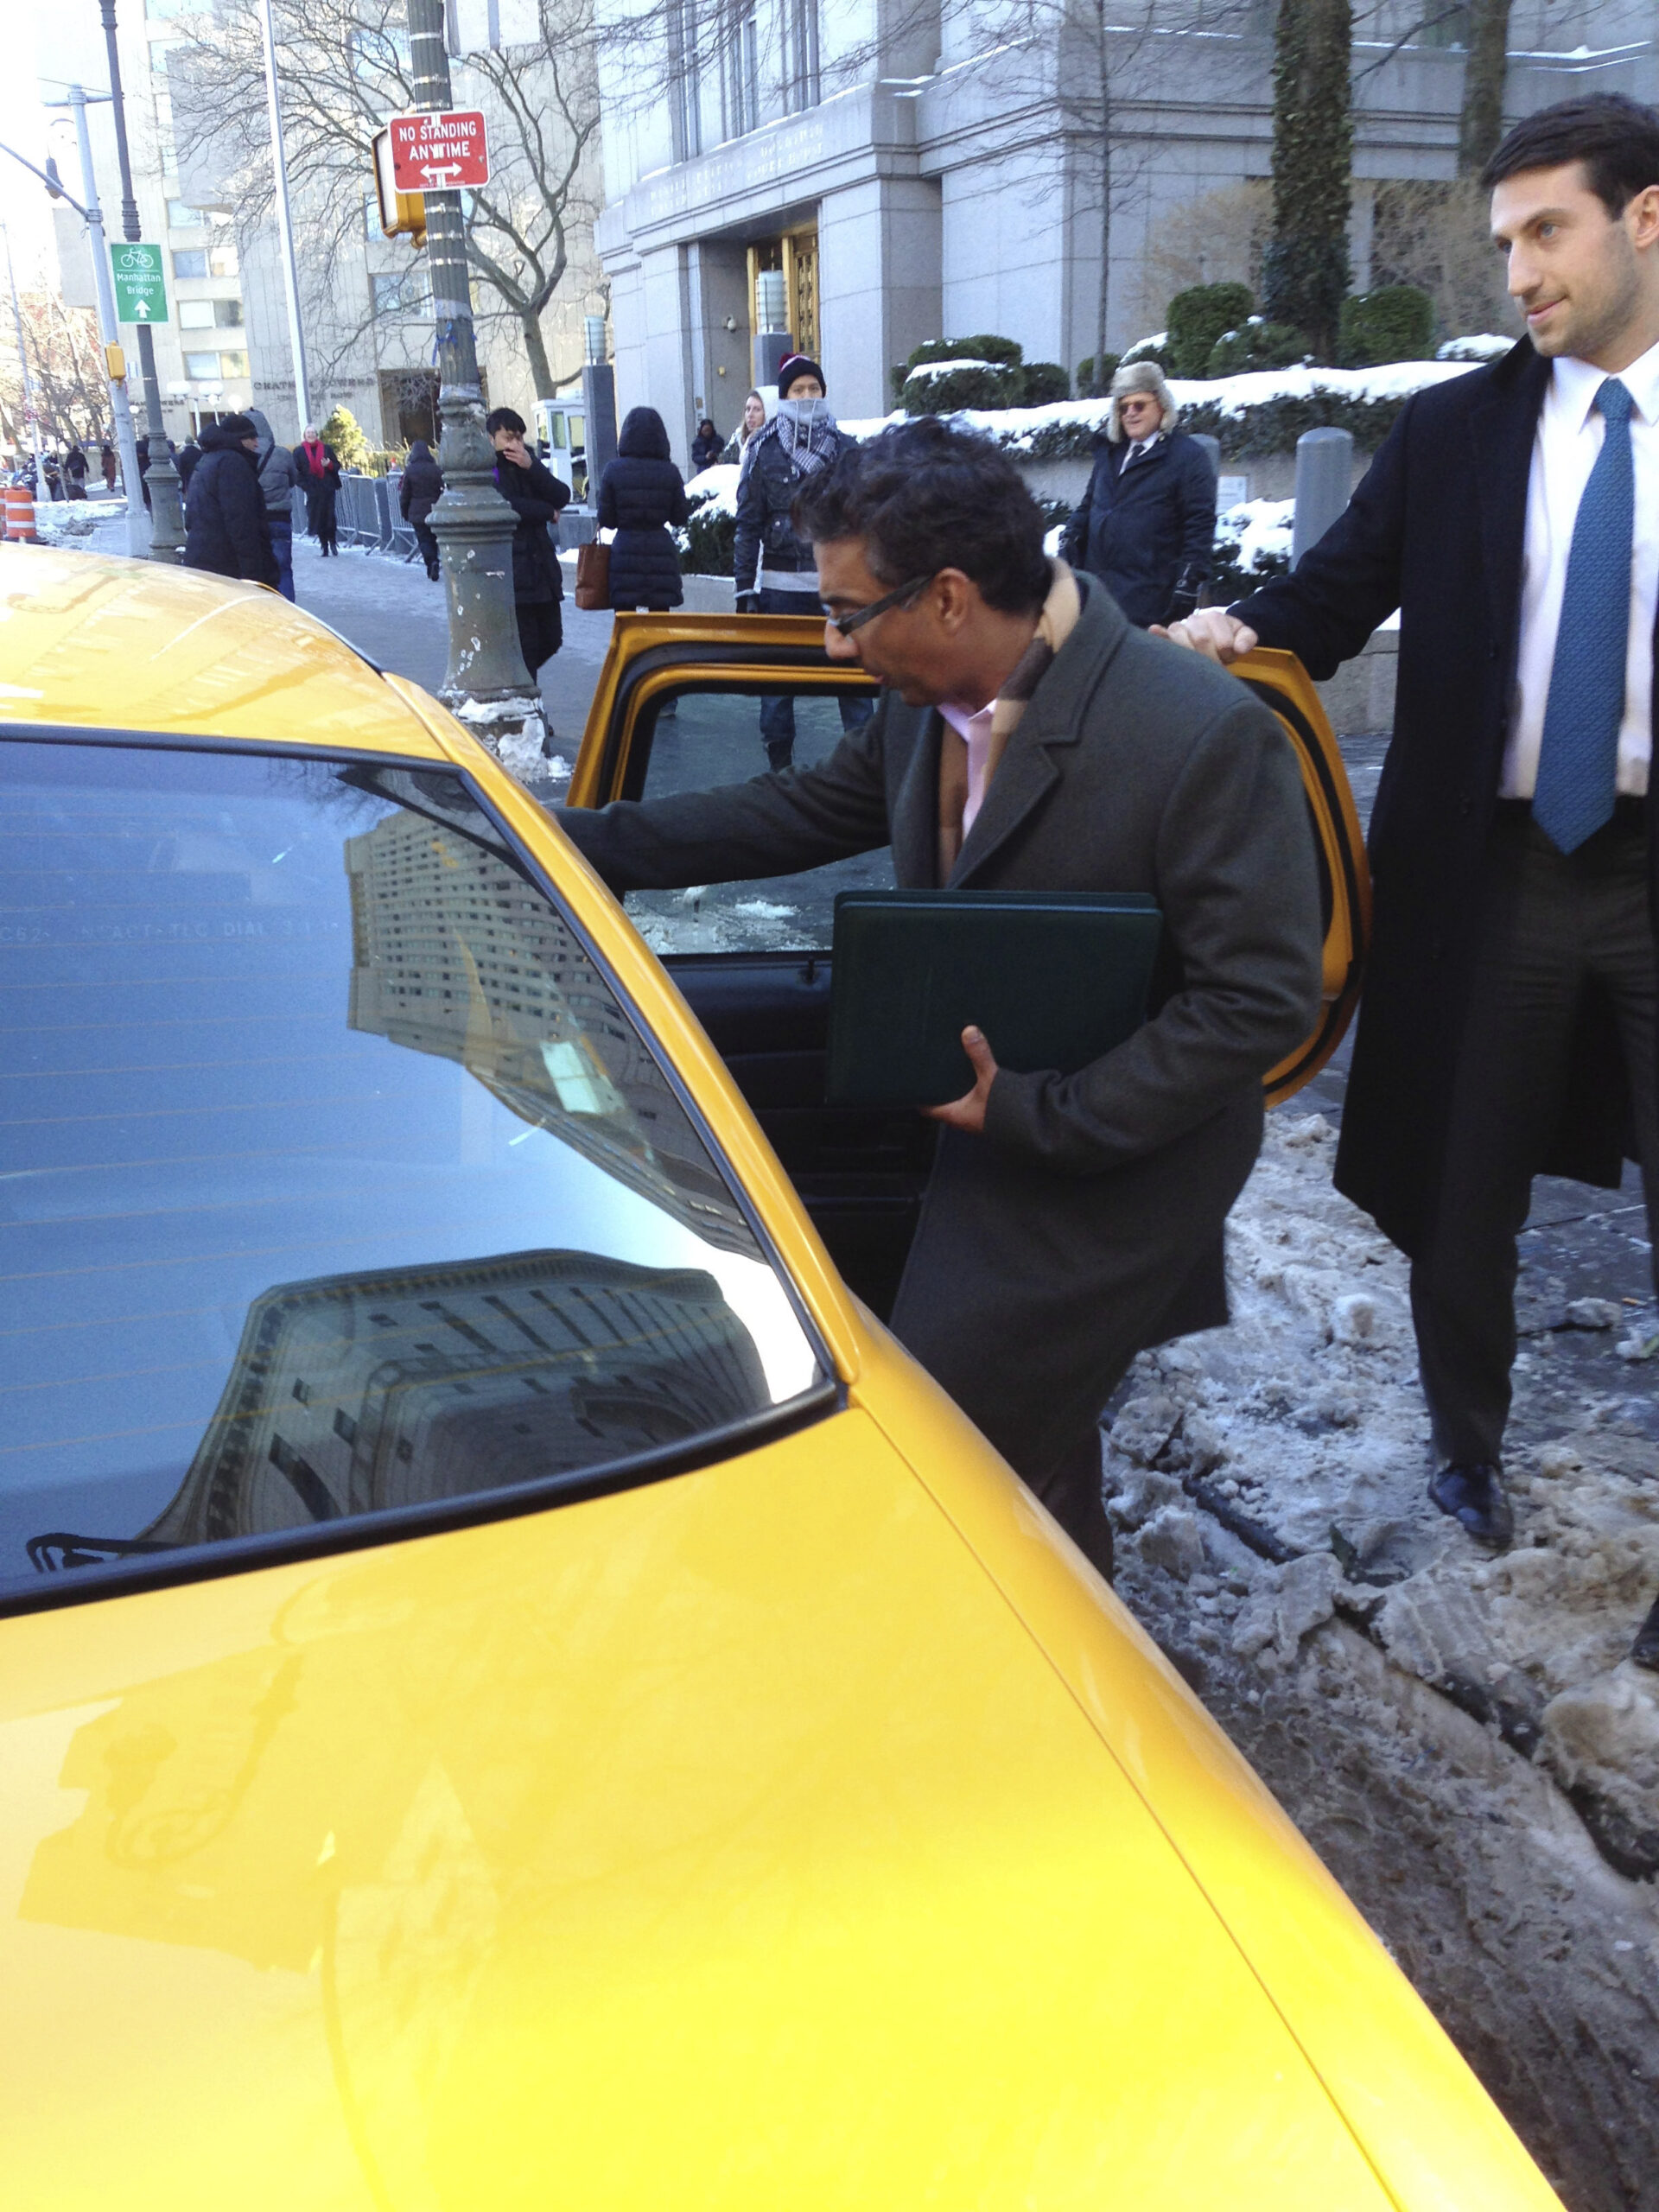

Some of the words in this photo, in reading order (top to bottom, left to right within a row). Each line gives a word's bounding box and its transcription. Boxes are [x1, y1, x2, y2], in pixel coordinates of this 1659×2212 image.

[399, 126, 416, 142] NO
[420, 121, 477, 140] STANDING
[409, 141, 471, 161] ANYTIME
[117, 273, 161, 282] Manhattan
[126, 286, 154, 296] Bridge
